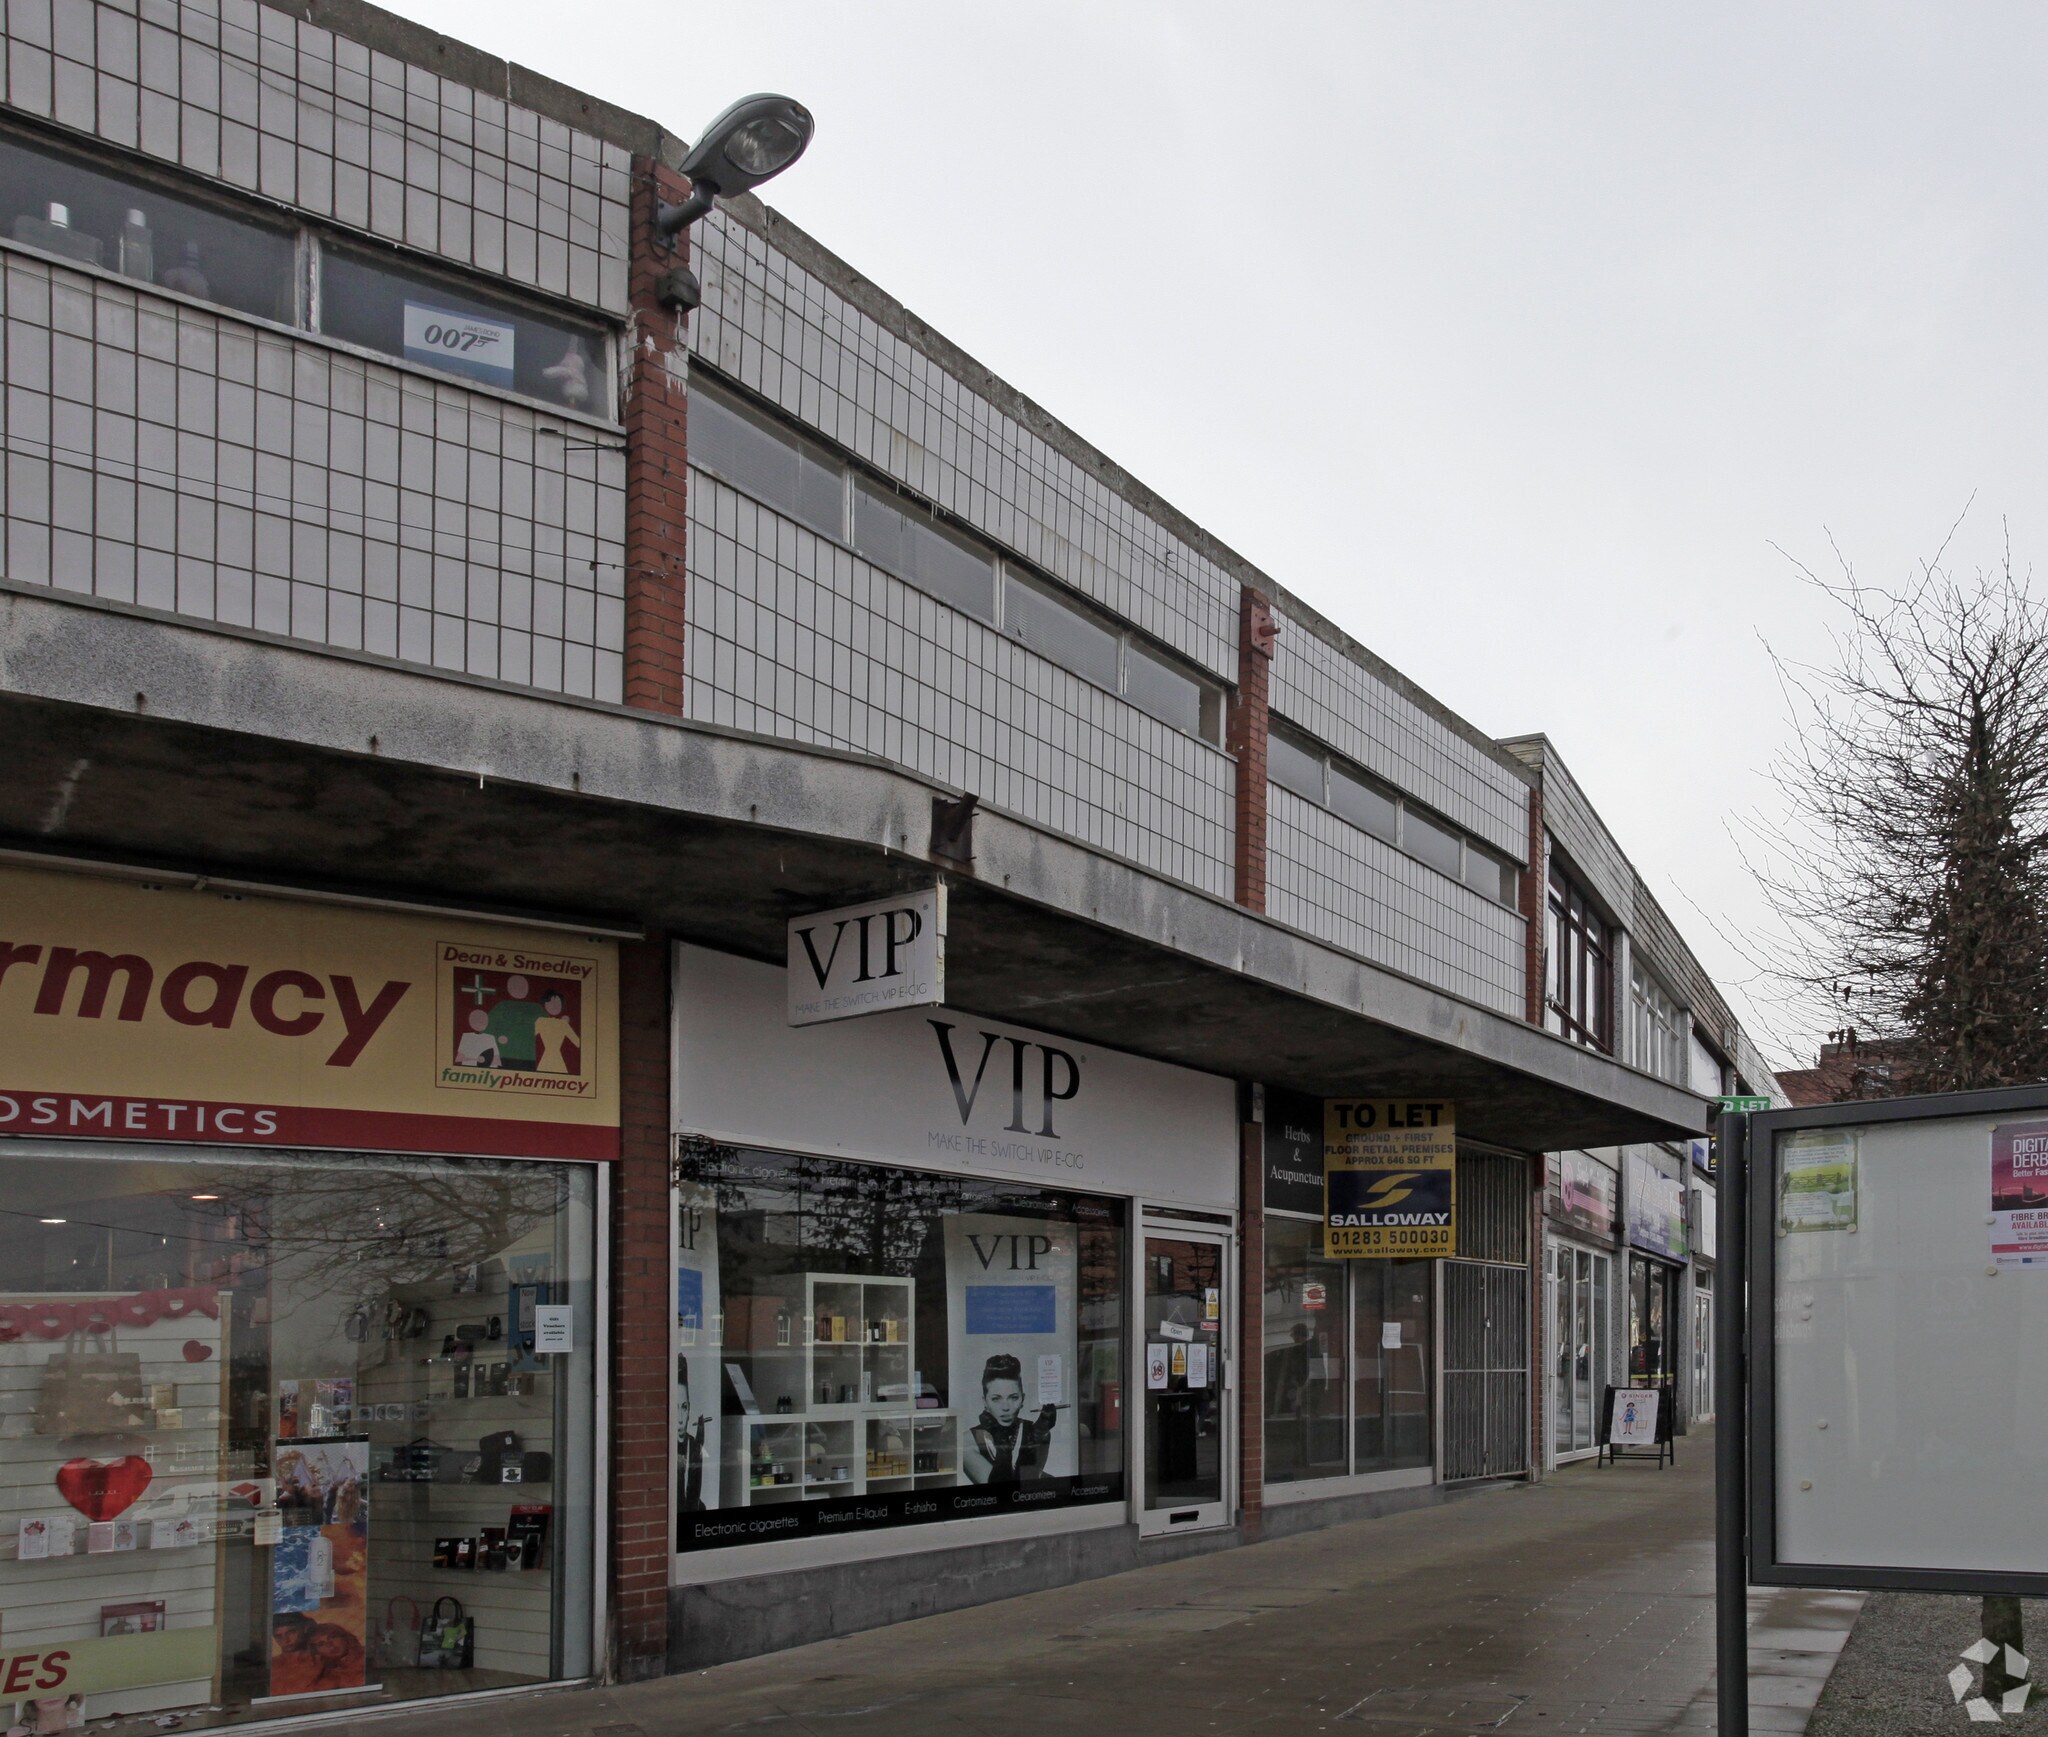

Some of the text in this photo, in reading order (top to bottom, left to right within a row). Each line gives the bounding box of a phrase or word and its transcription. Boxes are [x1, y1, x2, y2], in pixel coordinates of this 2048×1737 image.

[424, 324, 479, 351] 007
[794, 908, 922, 990] VIP
[443, 947, 593, 978] Dean & Smedley
[795, 1003, 820, 1015] MAKE
[824, 997, 840, 1010] THE
[882, 988, 897, 1001] VIP
[899, 983, 927, 998] E-CIG
[926, 1018, 1080, 1139] VIP
[1740, 1100, 1767, 1111] LET
[1334, 1104, 1443, 1128] TO LET
[1285, 1125, 1311, 1143] Herbs
[1346, 1133, 1390, 1143] GROUND
[1404, 1133, 1433, 1142] FIRST
[928, 1132, 961, 1151] MAKE
[965, 1136, 987, 1155] THE
[1038, 1148, 1053, 1164] VIP
[1055, 1151, 1084, 1169] E-CIG
[1293, 1148, 1302, 1162] &
[1325, 1144, 1453, 1155] FLOOR RETAIL PREMISES
[1345, 1156, 1434, 1165] APPROX 646 SQ FT
[2013, 1169, 2033, 1178] Better
[1330, 1212, 1449, 1227] SALLOWAY
[2011, 1212, 2034, 1221] FIBRE
[1331, 1230, 1449, 1245] 01283 500030
[966, 1234, 1052, 1270] VIP
[1333, 1247, 1447, 1255] www.salloway.com
[1170, 1326, 1183, 1336] Open
[1011, 1489, 1057, 1503] Clearomizers
[1071, 1484, 1109, 1496] Accessories
[905, 1501, 937, 1515] E-shisha
[953, 1495, 998, 1509] Cartomizers
[818, 1505, 889, 1524] Premium E-liquid
[695, 1516, 799, 1538] Electronic cigarettes
